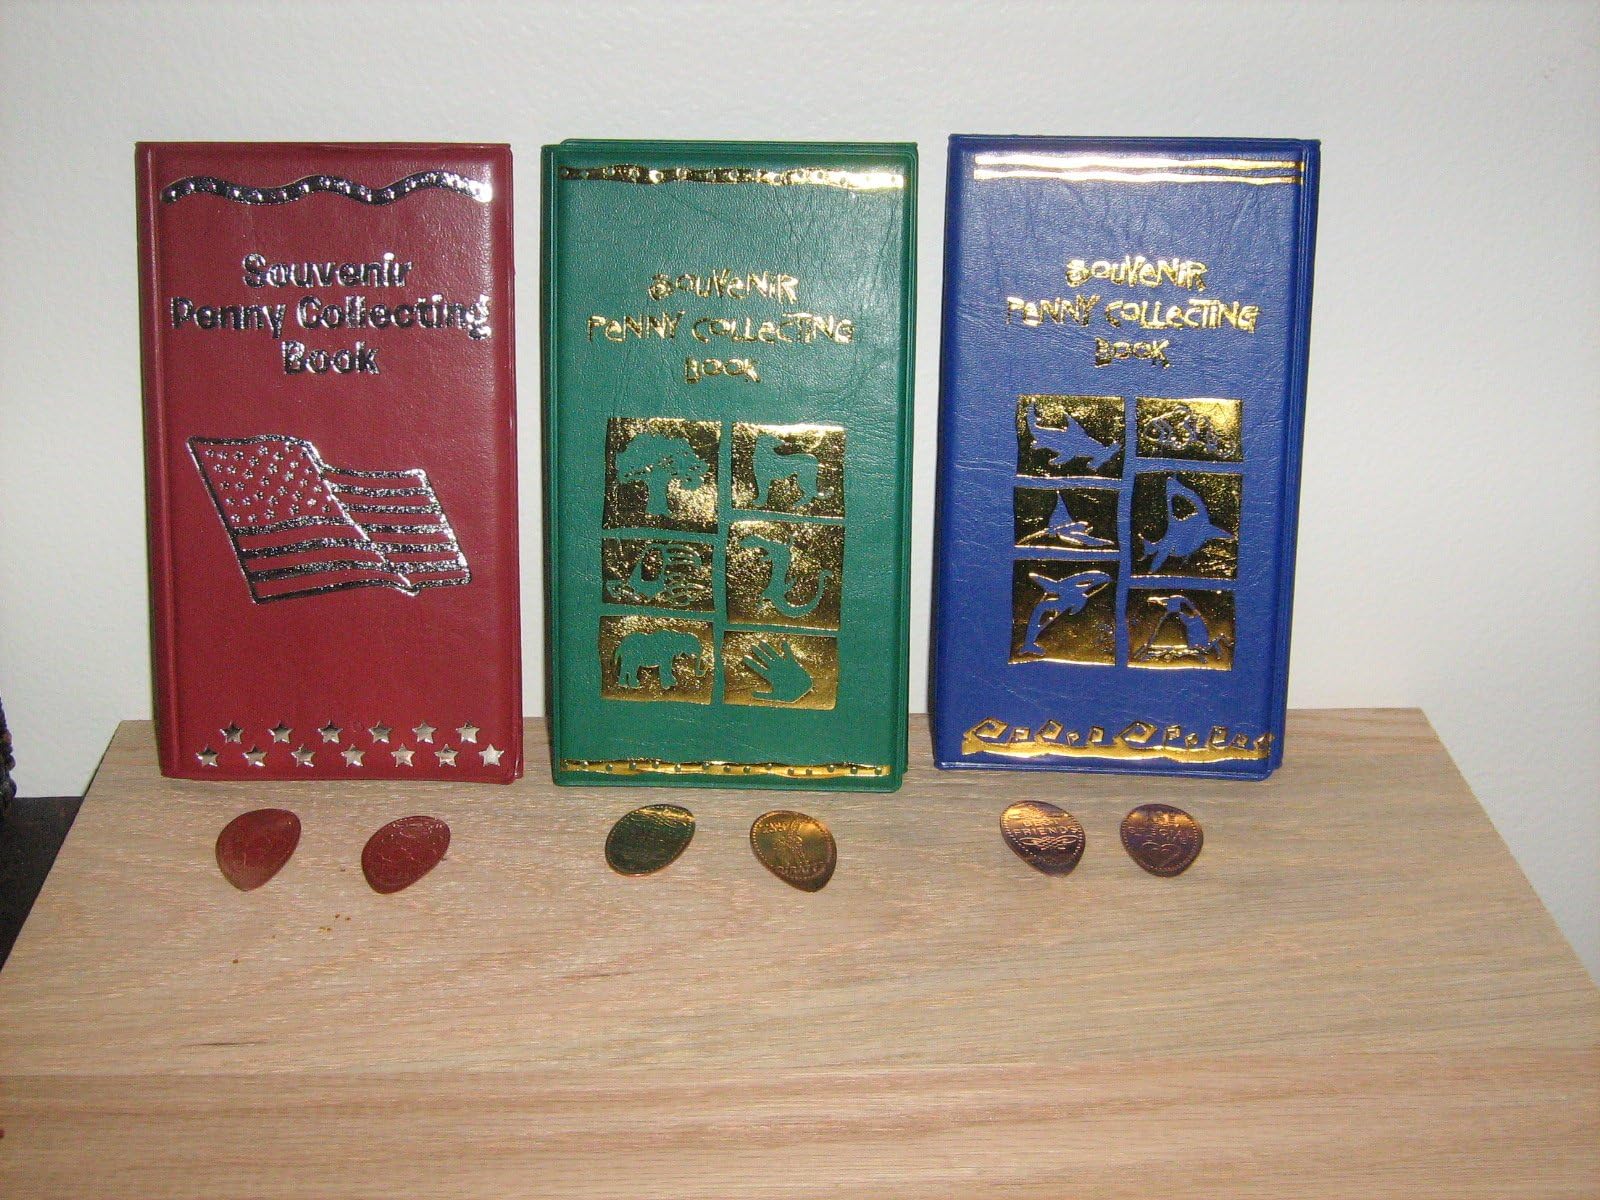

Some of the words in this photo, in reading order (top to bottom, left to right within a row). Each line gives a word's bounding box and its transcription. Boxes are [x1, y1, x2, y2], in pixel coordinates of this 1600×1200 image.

[242, 252, 412, 289] Souvenir
[170, 296, 286, 339] Penny
[296, 294, 493, 340] Collecting
[281, 340, 381, 375] Book
[684, 356, 761, 384] BOOK
[1094, 337, 1171, 368] BOOK
